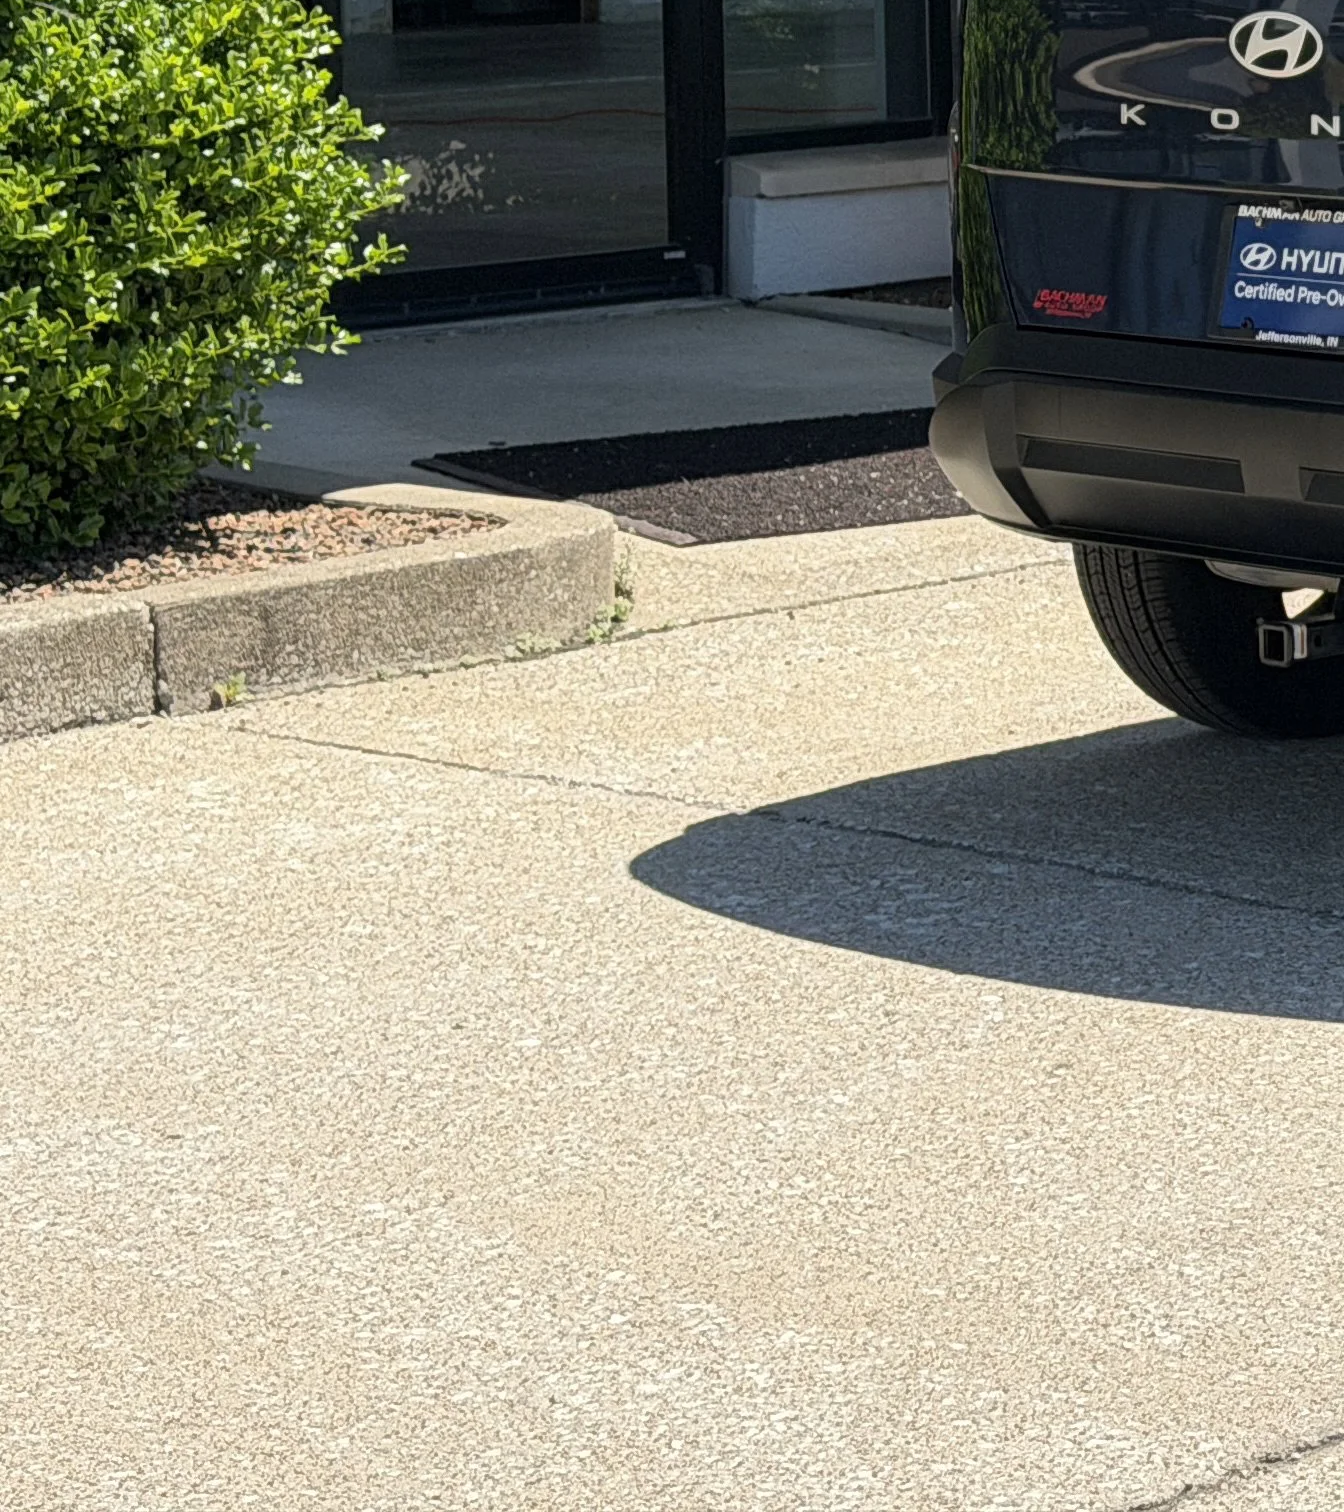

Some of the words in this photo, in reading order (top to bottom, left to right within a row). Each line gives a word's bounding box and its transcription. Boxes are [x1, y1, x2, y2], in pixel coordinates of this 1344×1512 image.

[1237, 204, 1300, 220] BACHMAN
[1301, 209, 1332, 223] AUTO
[1234, 280, 1295, 303] Certified
[1255, 329, 1325, 347] Jeffersonville,
[1326, 336, 1339, 347] IN
